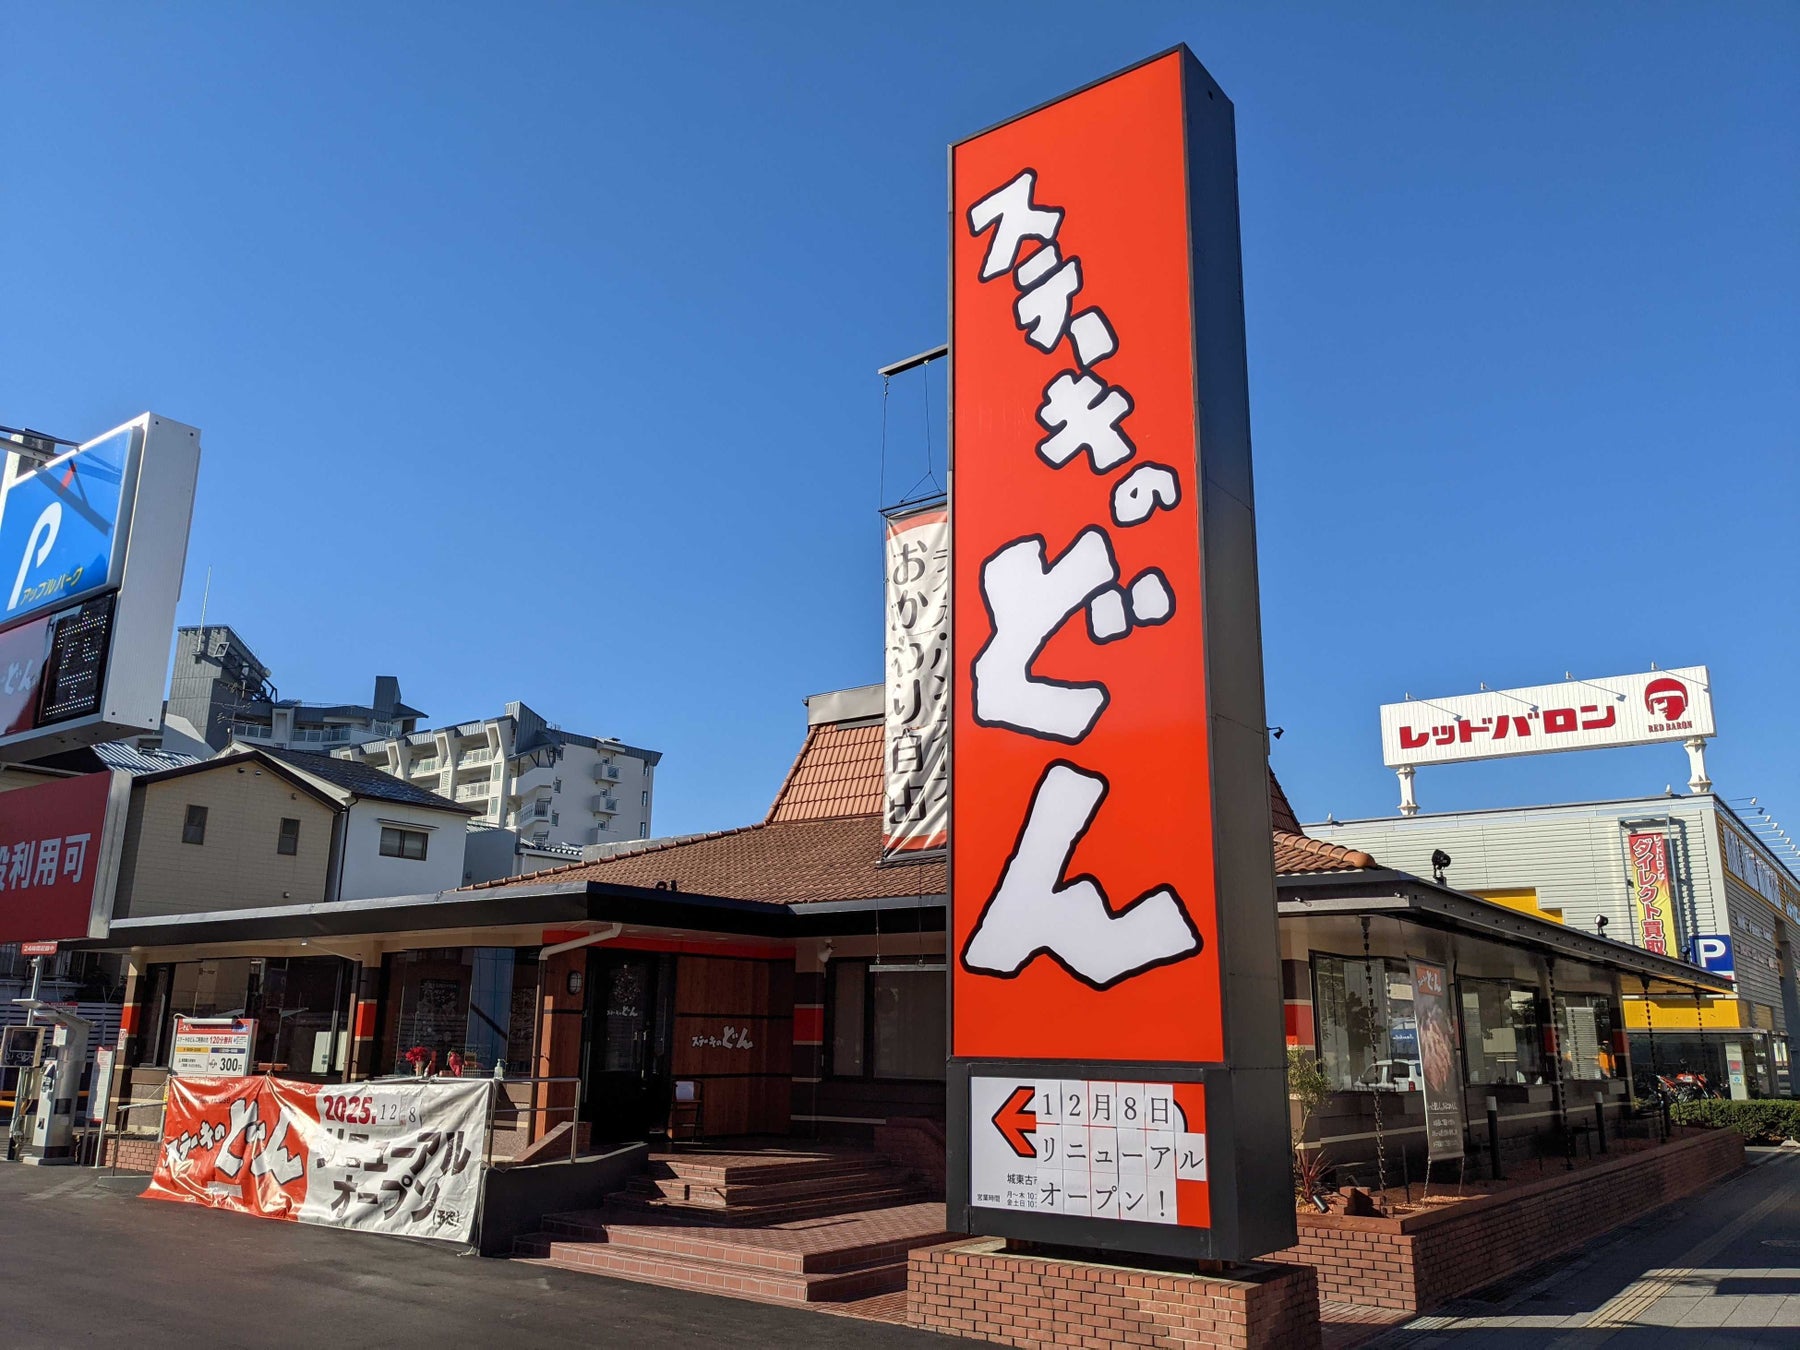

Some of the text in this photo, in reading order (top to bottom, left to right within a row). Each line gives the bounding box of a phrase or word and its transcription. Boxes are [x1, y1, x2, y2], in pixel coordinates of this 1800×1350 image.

[21, 566, 84, 606] アップルパーク
[959, 166, 1203, 991] ステーキのどん
[45, 606, 107, 715] 空
[892, 539, 928, 825] おかわり自由
[1400, 705, 1615, 749] レッドバロン
[1648, 720, 1692, 733] RED BARON
[1632, 837, 1667, 956] ダイレクト買取
[1700, 938, 1726, 968] P
[691, 1026, 753, 1049] ステーキのどん
[323, 1095, 377, 1124] 2025.
[1043, 1093, 1169, 1124] 12月8日
[163, 1097, 304, 1186] ステーキのどん
[1043, 1137, 1204, 1169] リニューアル
[330, 1174, 440, 1222] オープン
[977, 1193, 1000, 1202] 営業時間
